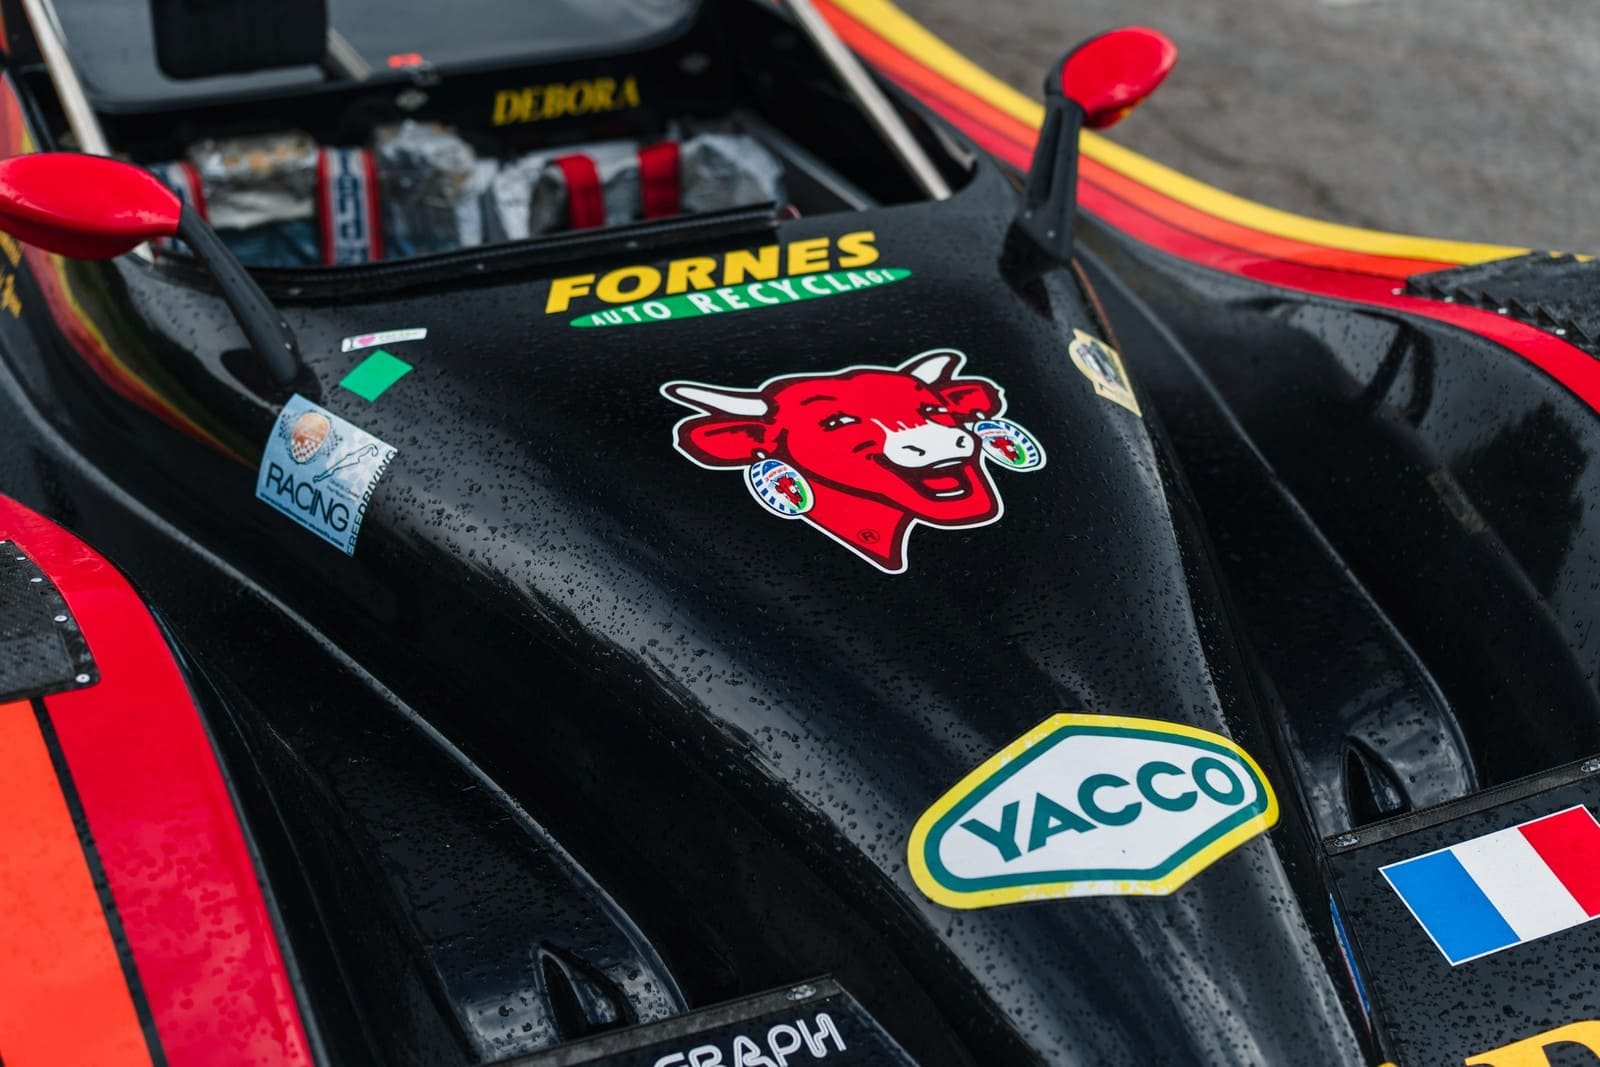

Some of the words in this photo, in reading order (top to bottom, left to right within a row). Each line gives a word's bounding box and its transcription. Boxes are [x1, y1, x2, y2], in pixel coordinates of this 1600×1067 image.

[493, 77, 640, 126] DEBORA
[545, 231, 879, 314] FORNES
[591, 303, 672, 327] AUTO
[266, 462, 350, 533] RACING
[959, 756, 1246, 863] YACCO
